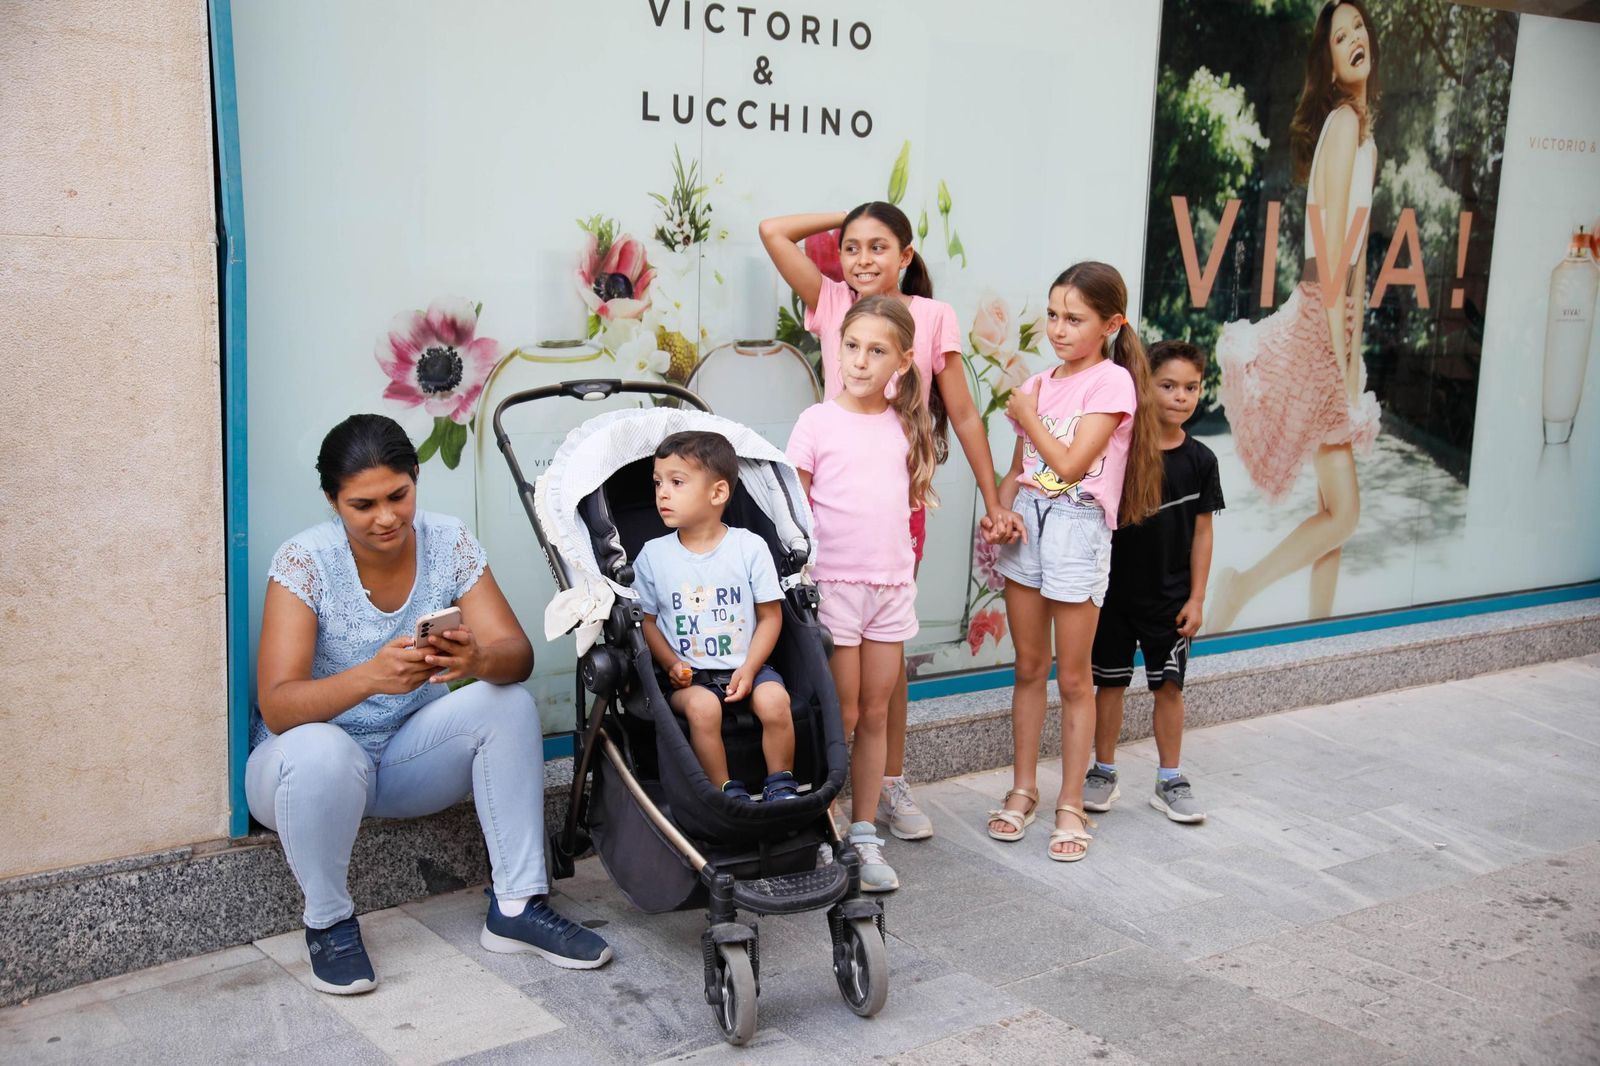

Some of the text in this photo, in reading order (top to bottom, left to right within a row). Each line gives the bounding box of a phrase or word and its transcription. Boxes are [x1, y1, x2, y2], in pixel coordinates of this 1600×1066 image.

[649, 0, 872, 50] VICTORIO
[753, 55, 773, 85] &
[642, 91, 873, 138] LUCCHINO
[1529, 136, 1586, 153] VICTORIO
[1171, 195, 1473, 309] VIVA!
[675, 615, 700, 635] EX
[711, 608, 727, 622] TO
